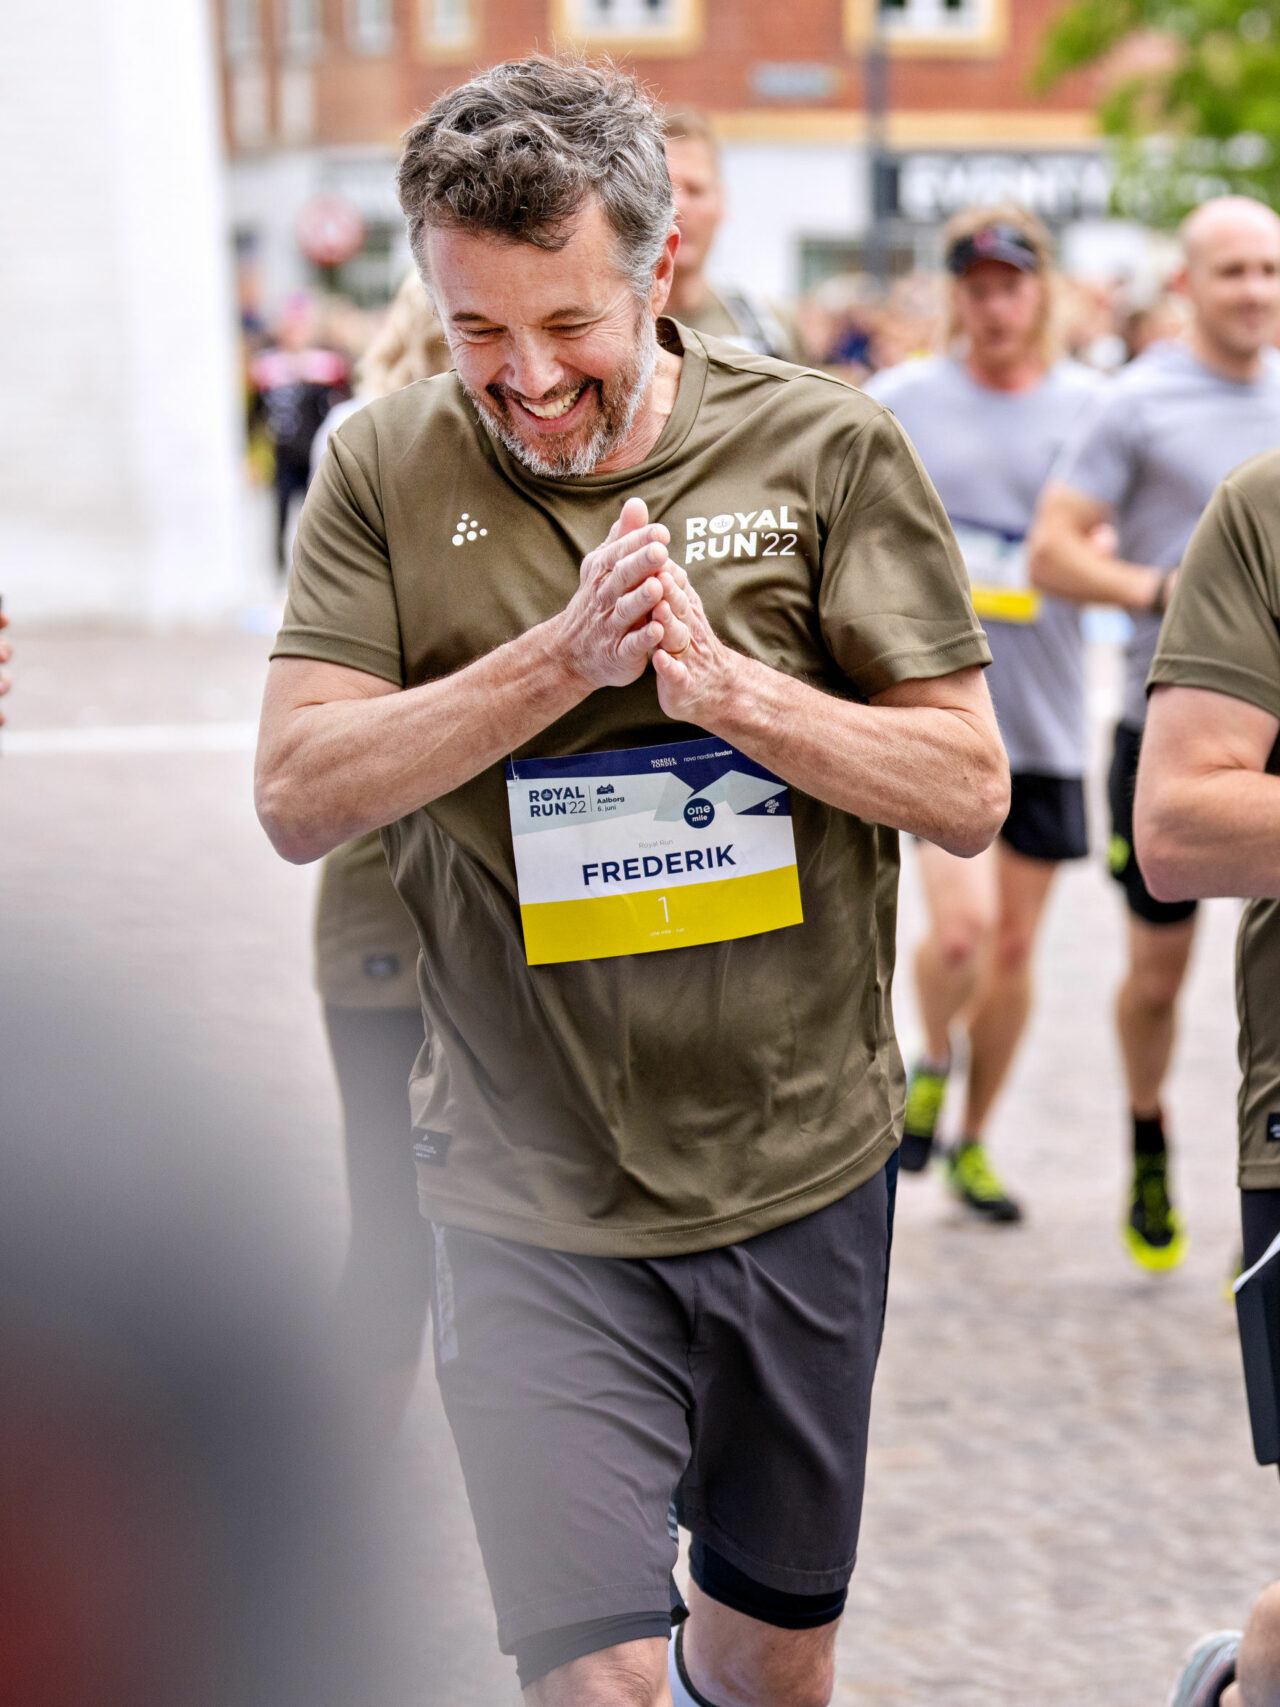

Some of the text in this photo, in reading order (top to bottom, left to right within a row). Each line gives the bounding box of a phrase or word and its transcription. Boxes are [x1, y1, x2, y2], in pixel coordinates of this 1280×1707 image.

[685, 505, 799, 541] ROYAL
[715, 750, 733, 758] fonden
[529, 786, 585, 803] ROYAL
[597, 796, 625, 804] Aalborg
[604, 804, 617, 812] juni
[687, 804, 711, 816] one
[692, 814, 708, 823] mile
[638, 841, 658, 849] Royal
[582, 844, 737, 886] FREDERIK
[657, 895, 669, 924] 1
